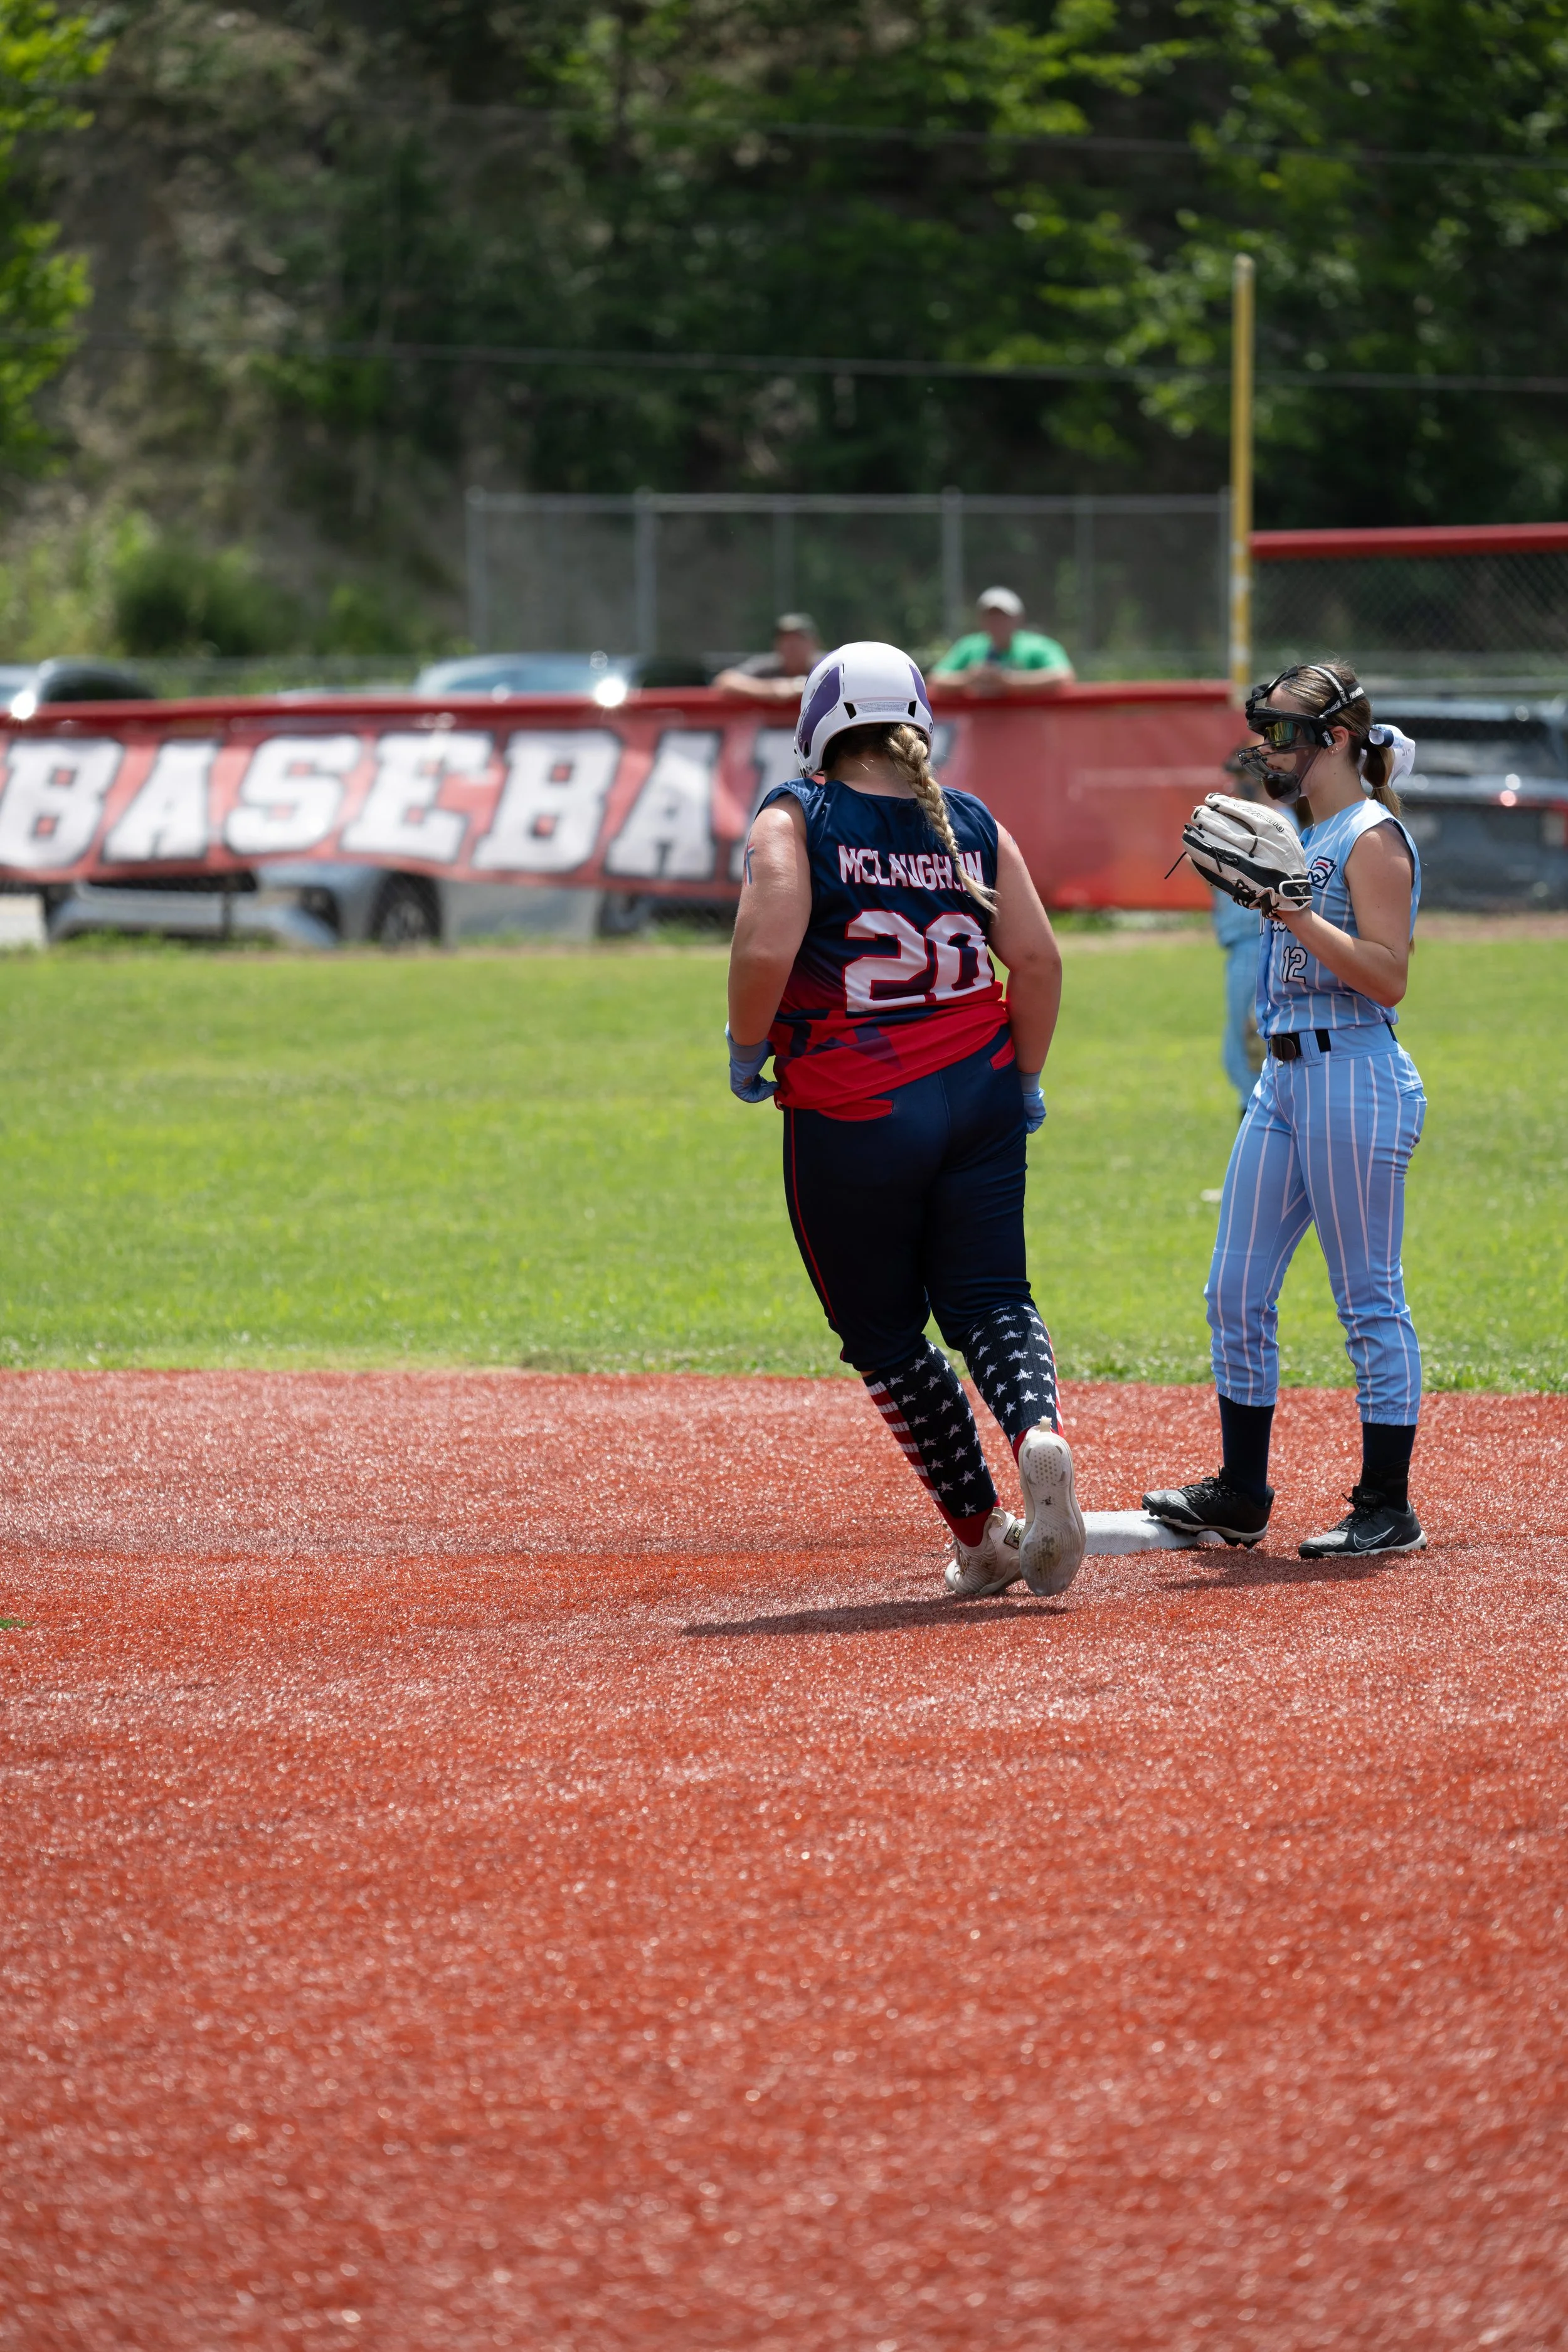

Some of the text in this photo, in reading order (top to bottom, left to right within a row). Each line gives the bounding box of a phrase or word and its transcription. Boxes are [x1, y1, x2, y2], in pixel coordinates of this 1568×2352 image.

[0, 725, 960, 881] BASEBA
[838, 845, 985, 891] MCLAUGHIN
[842, 909, 993, 1012] 20
[1283, 946, 1308, 985] 12
